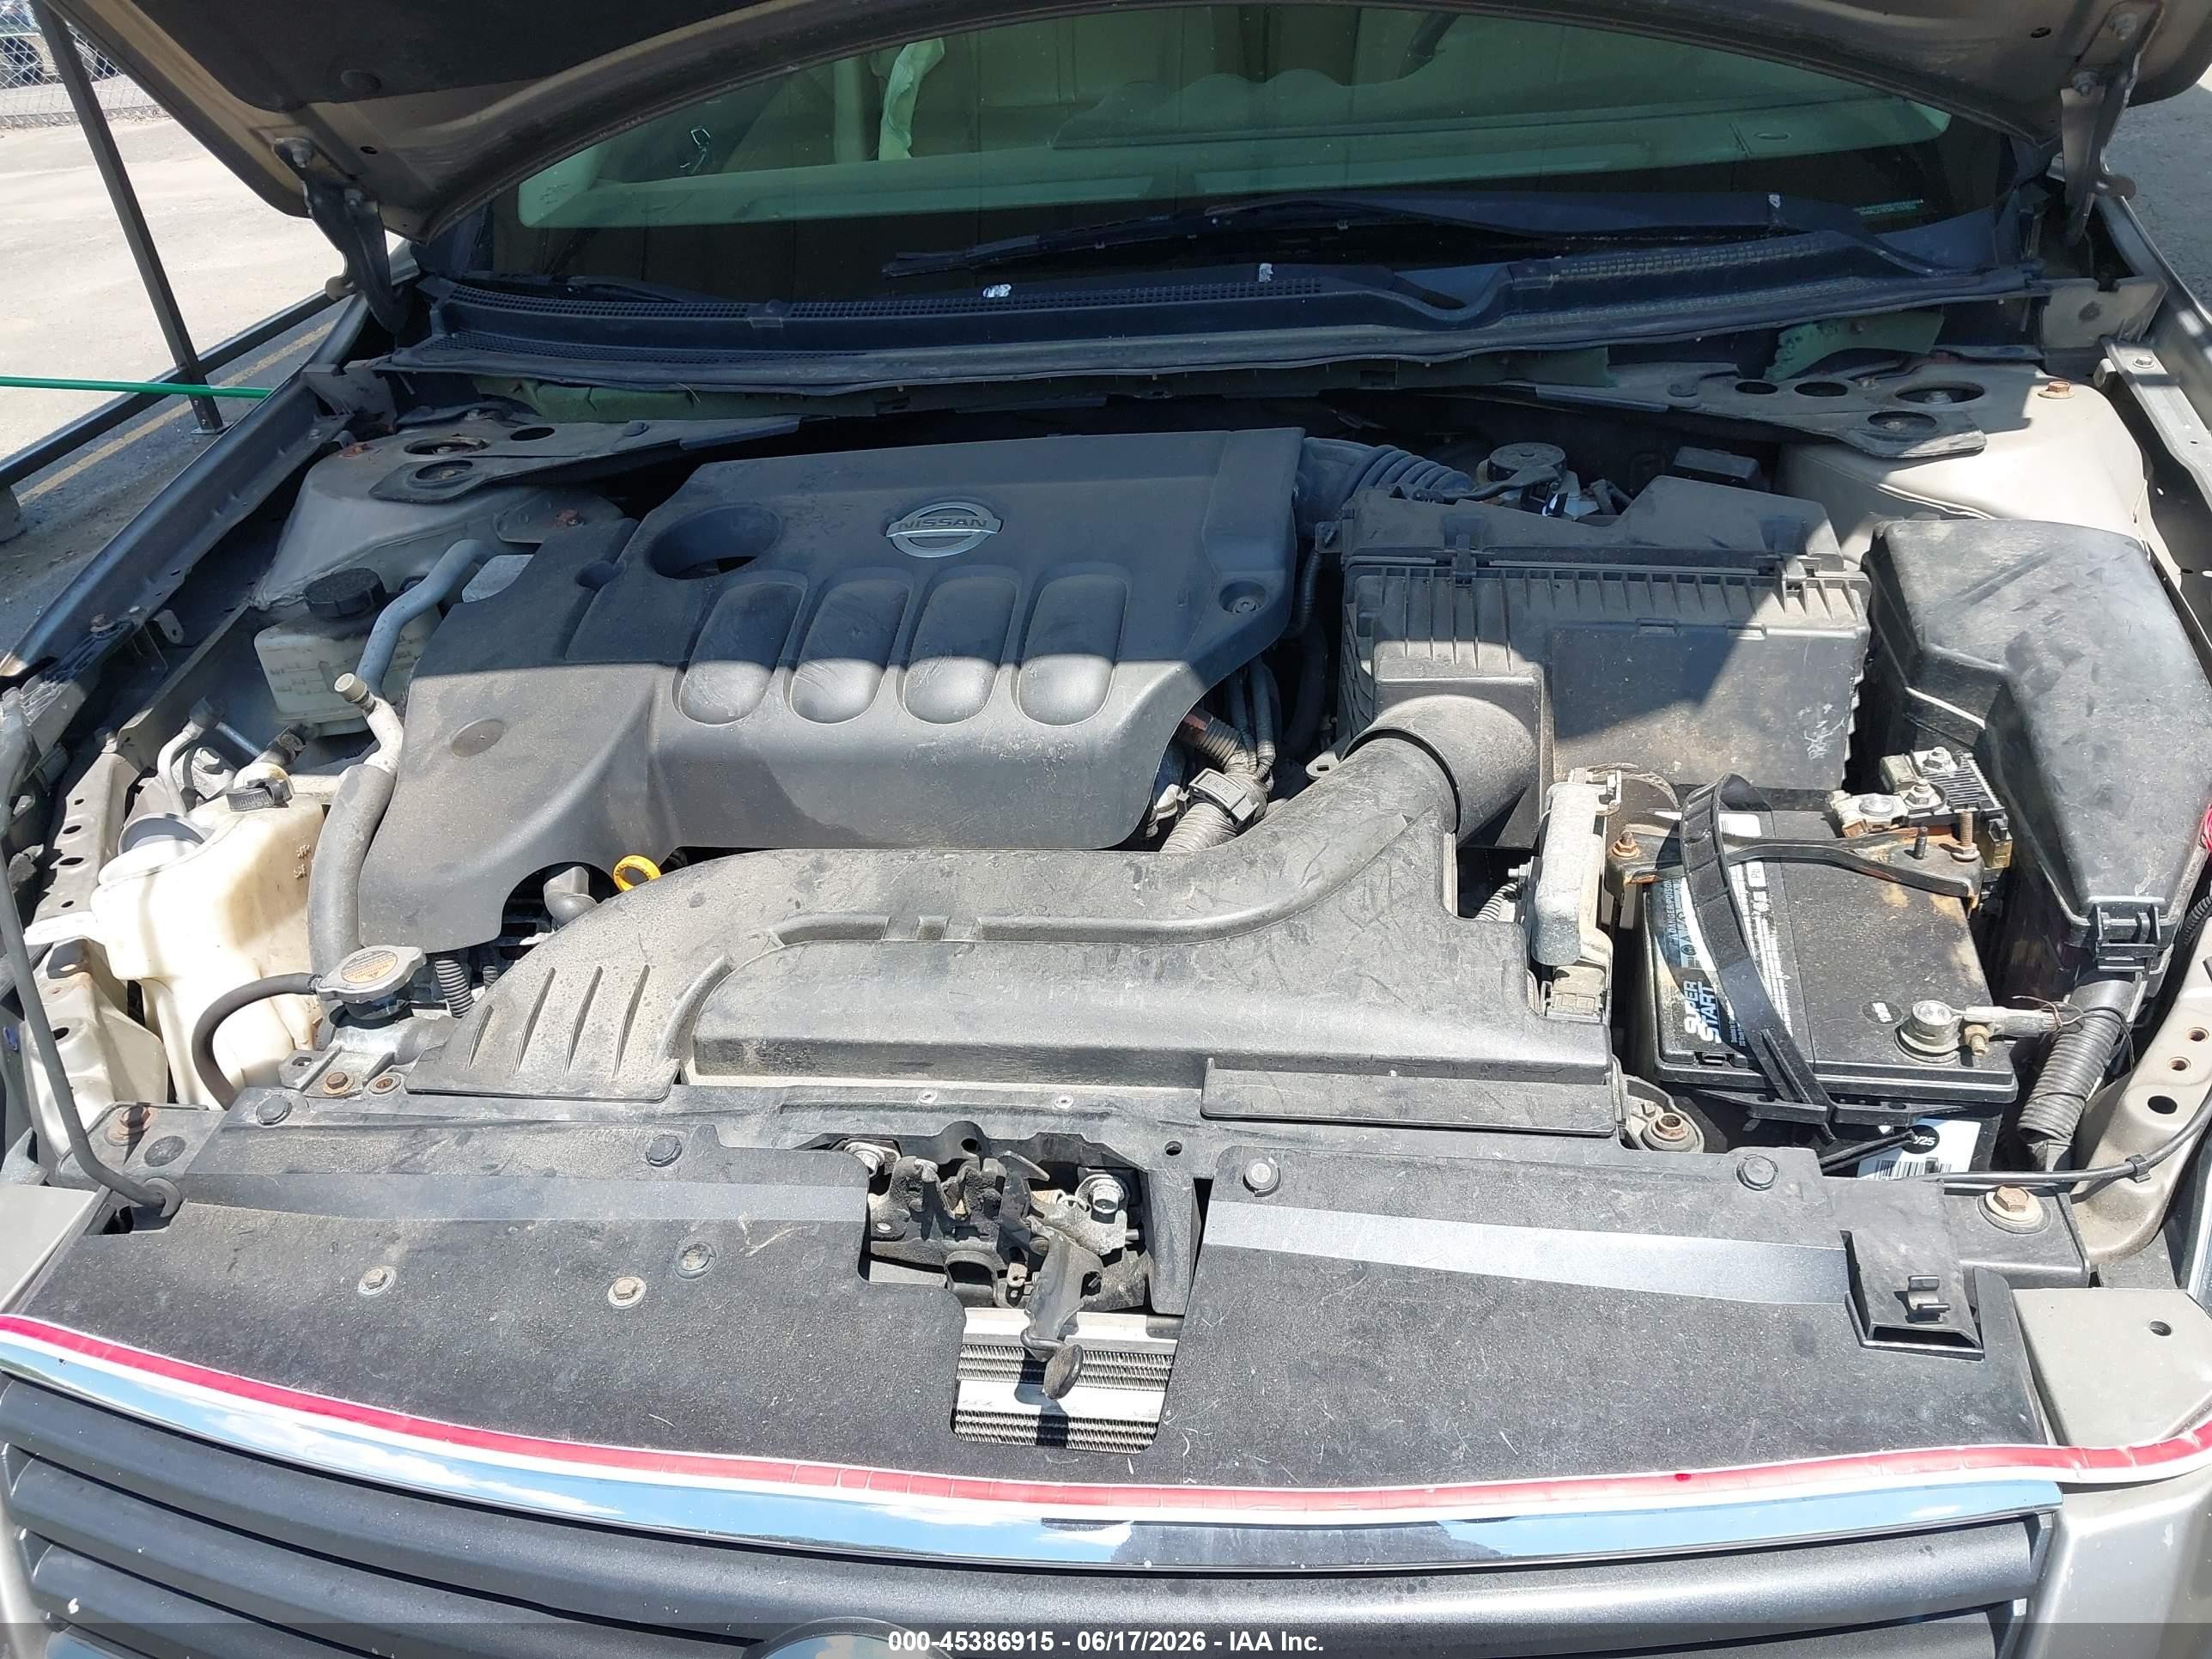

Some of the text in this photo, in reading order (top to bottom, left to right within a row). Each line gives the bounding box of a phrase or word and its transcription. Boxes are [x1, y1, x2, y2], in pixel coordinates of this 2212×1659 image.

[897, 518, 988, 530] NISSAN
[1684, 980, 1701, 1034] SUPER
[1698, 981, 1723, 1044] START
